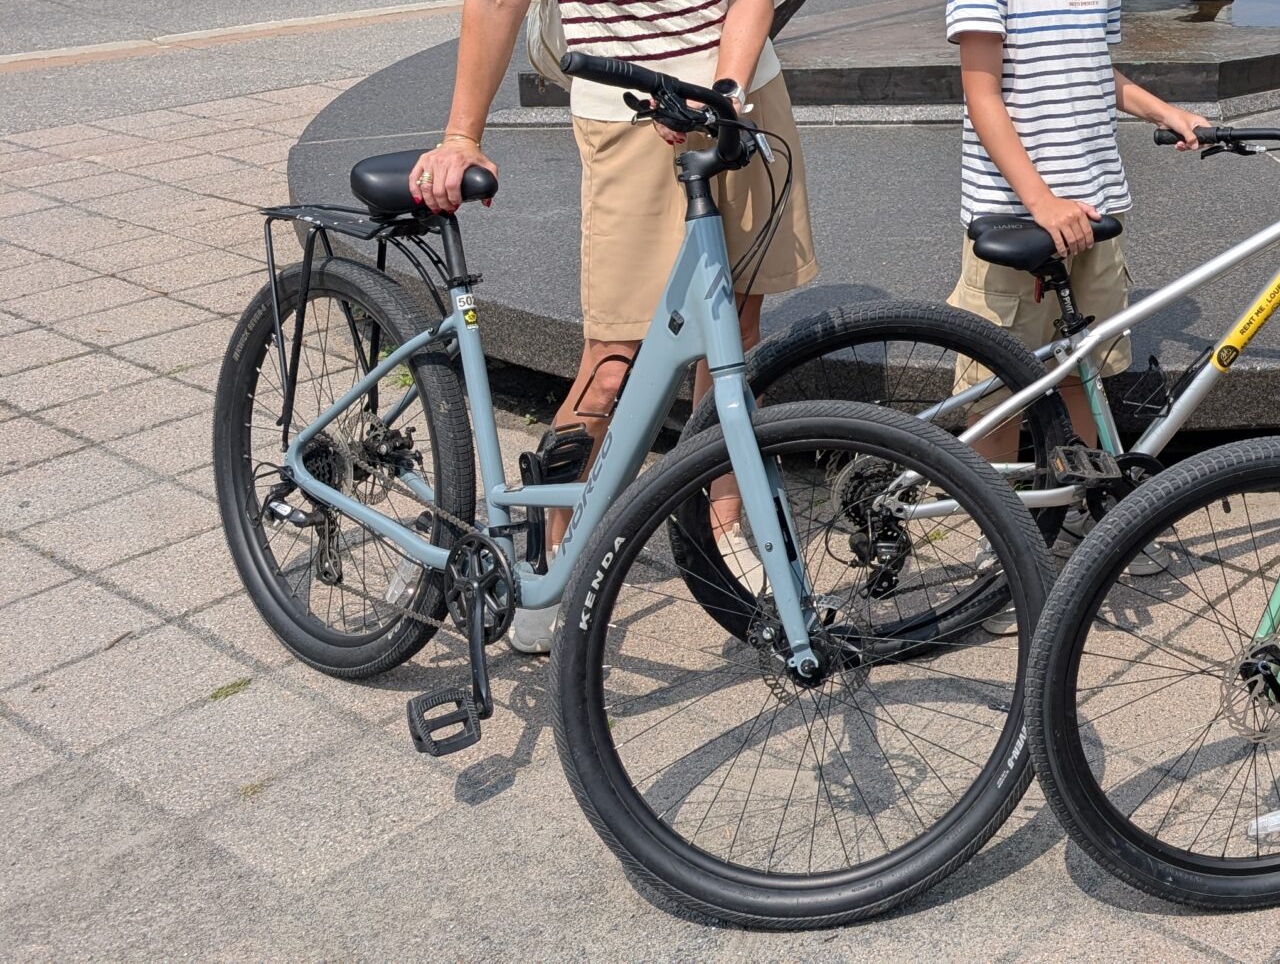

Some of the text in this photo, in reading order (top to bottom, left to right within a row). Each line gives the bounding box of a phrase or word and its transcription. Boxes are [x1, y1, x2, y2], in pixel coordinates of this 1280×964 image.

[1239, 316, 1257, 335] RENT
[1254, 305, 1266, 317] ME
[562, 431, 612, 557] NORCO
[579, 536, 626, 631] KENDA
